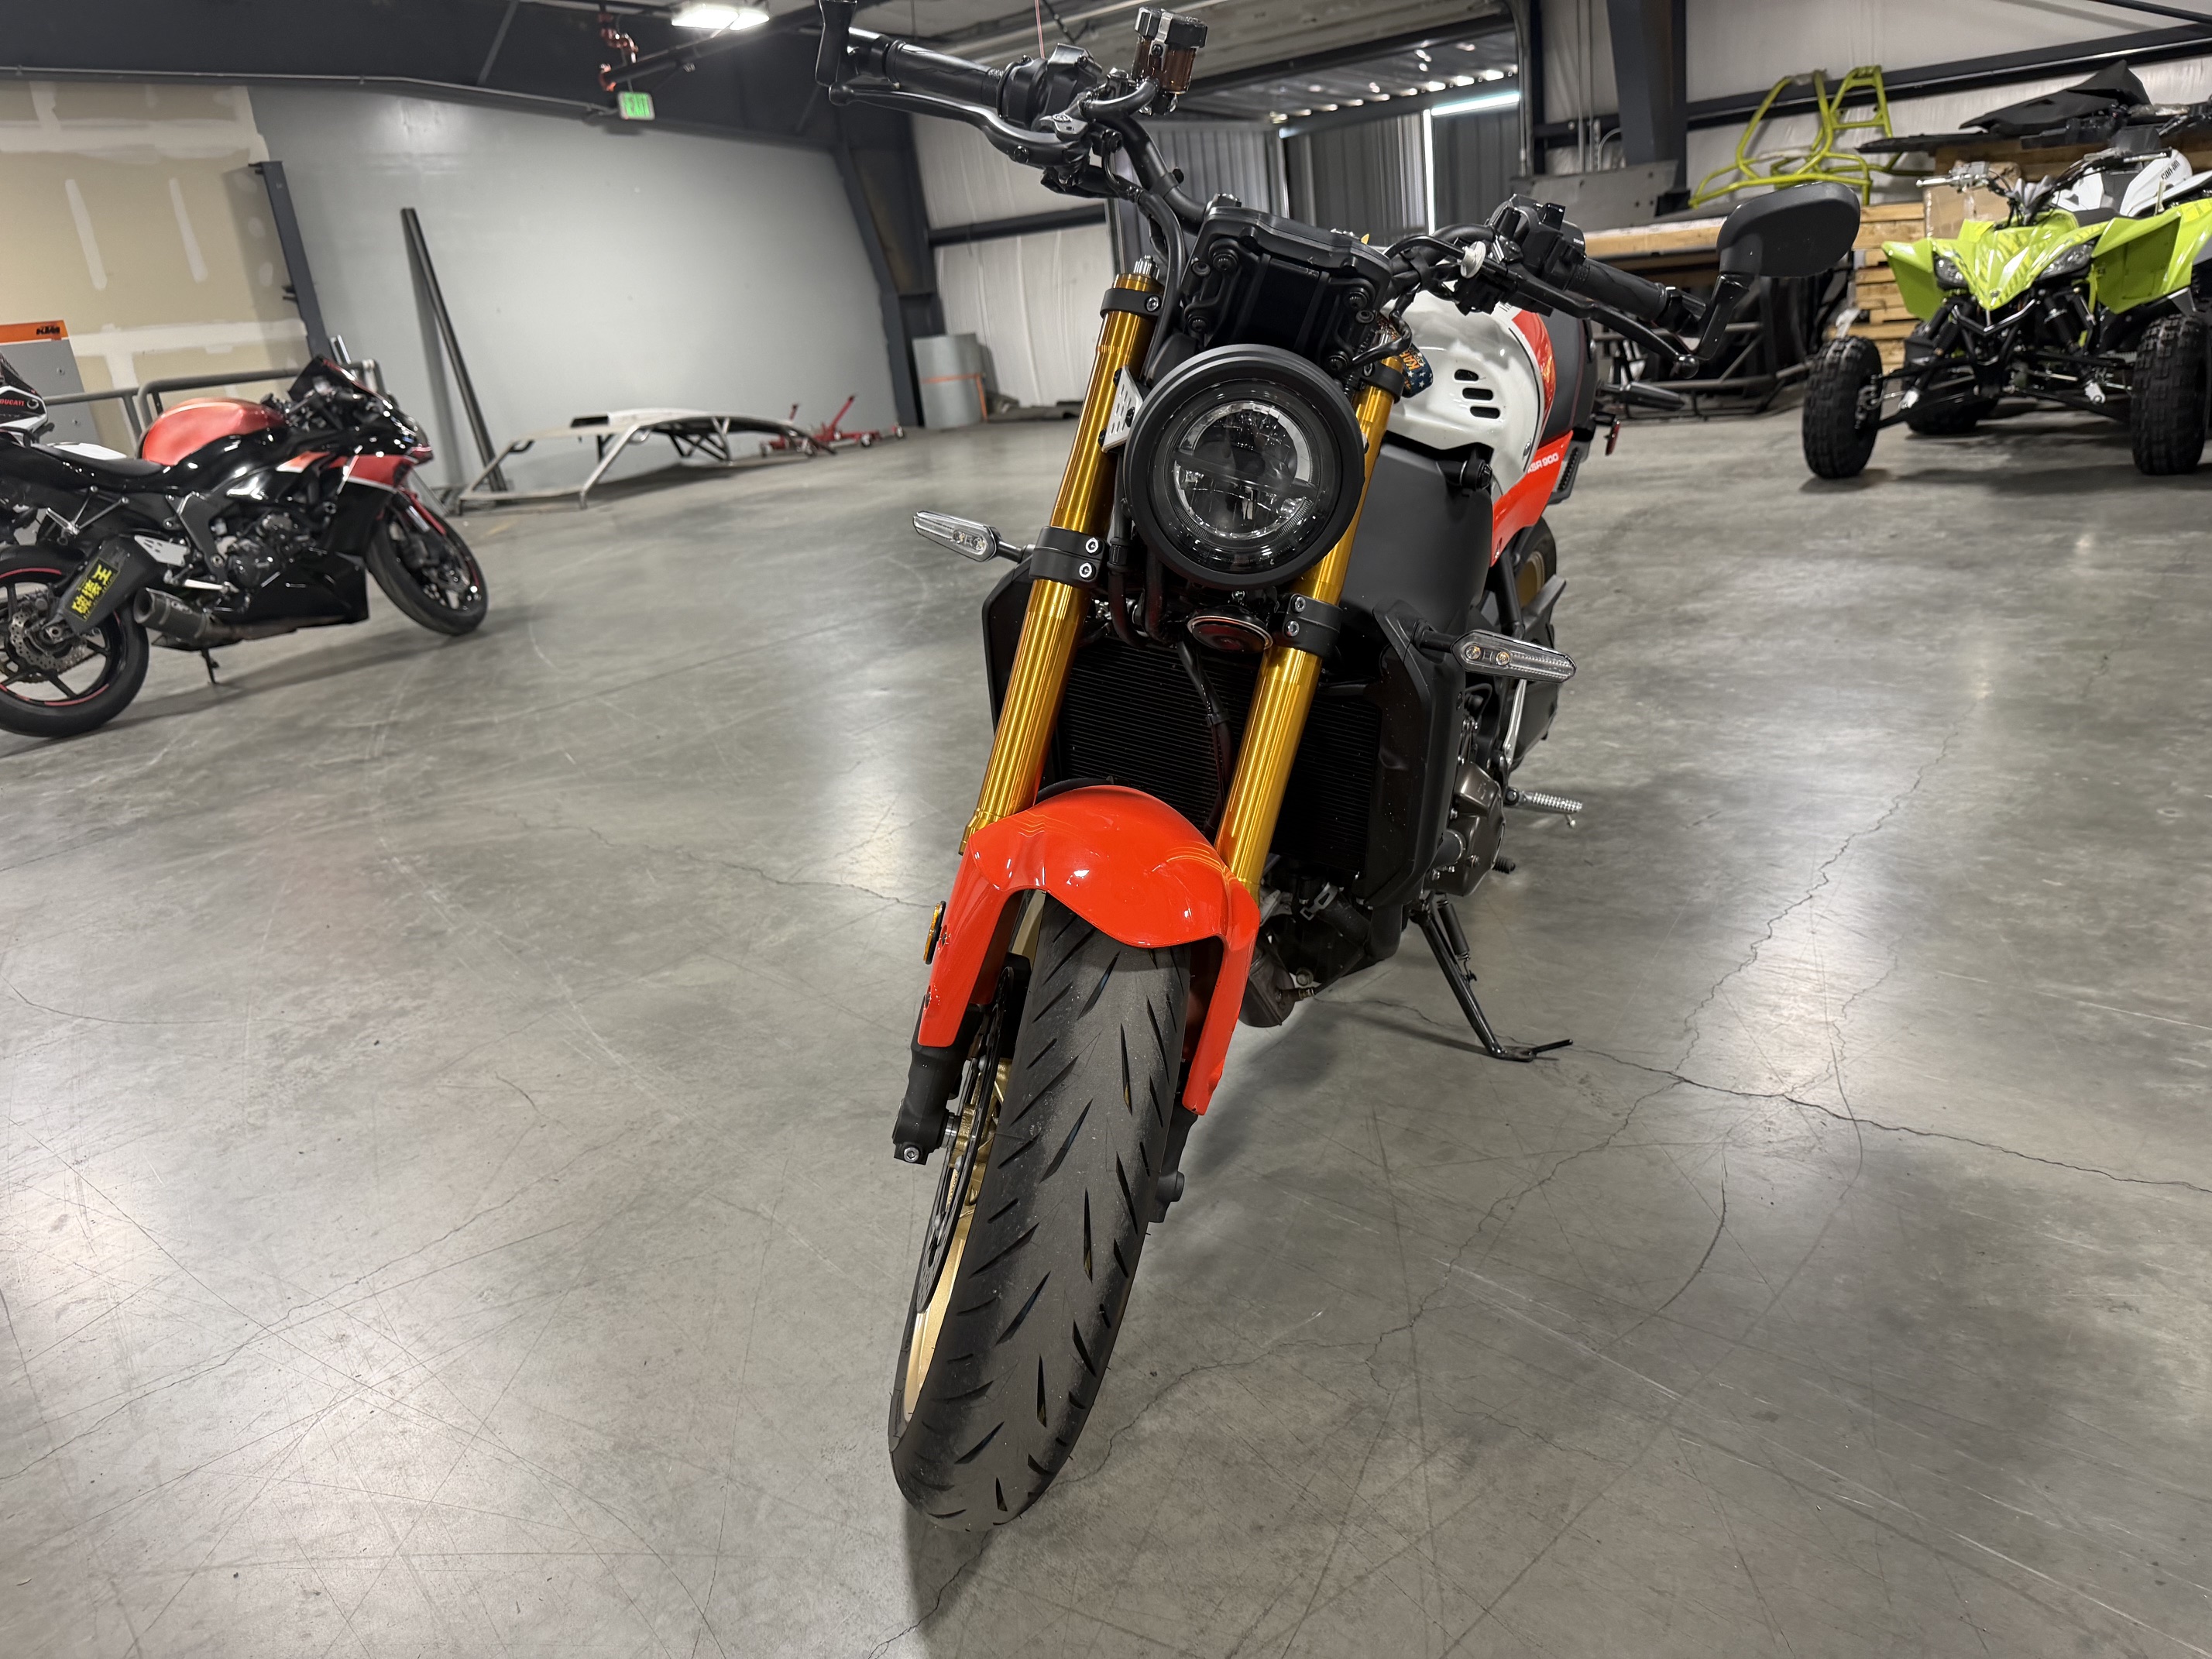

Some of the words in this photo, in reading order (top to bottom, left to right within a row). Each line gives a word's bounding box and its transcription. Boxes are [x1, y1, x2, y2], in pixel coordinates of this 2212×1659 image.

[36, 326, 60, 335] KTM
[0, 398, 25, 407] DUCATI
[1542, 452, 1560, 466] 900
